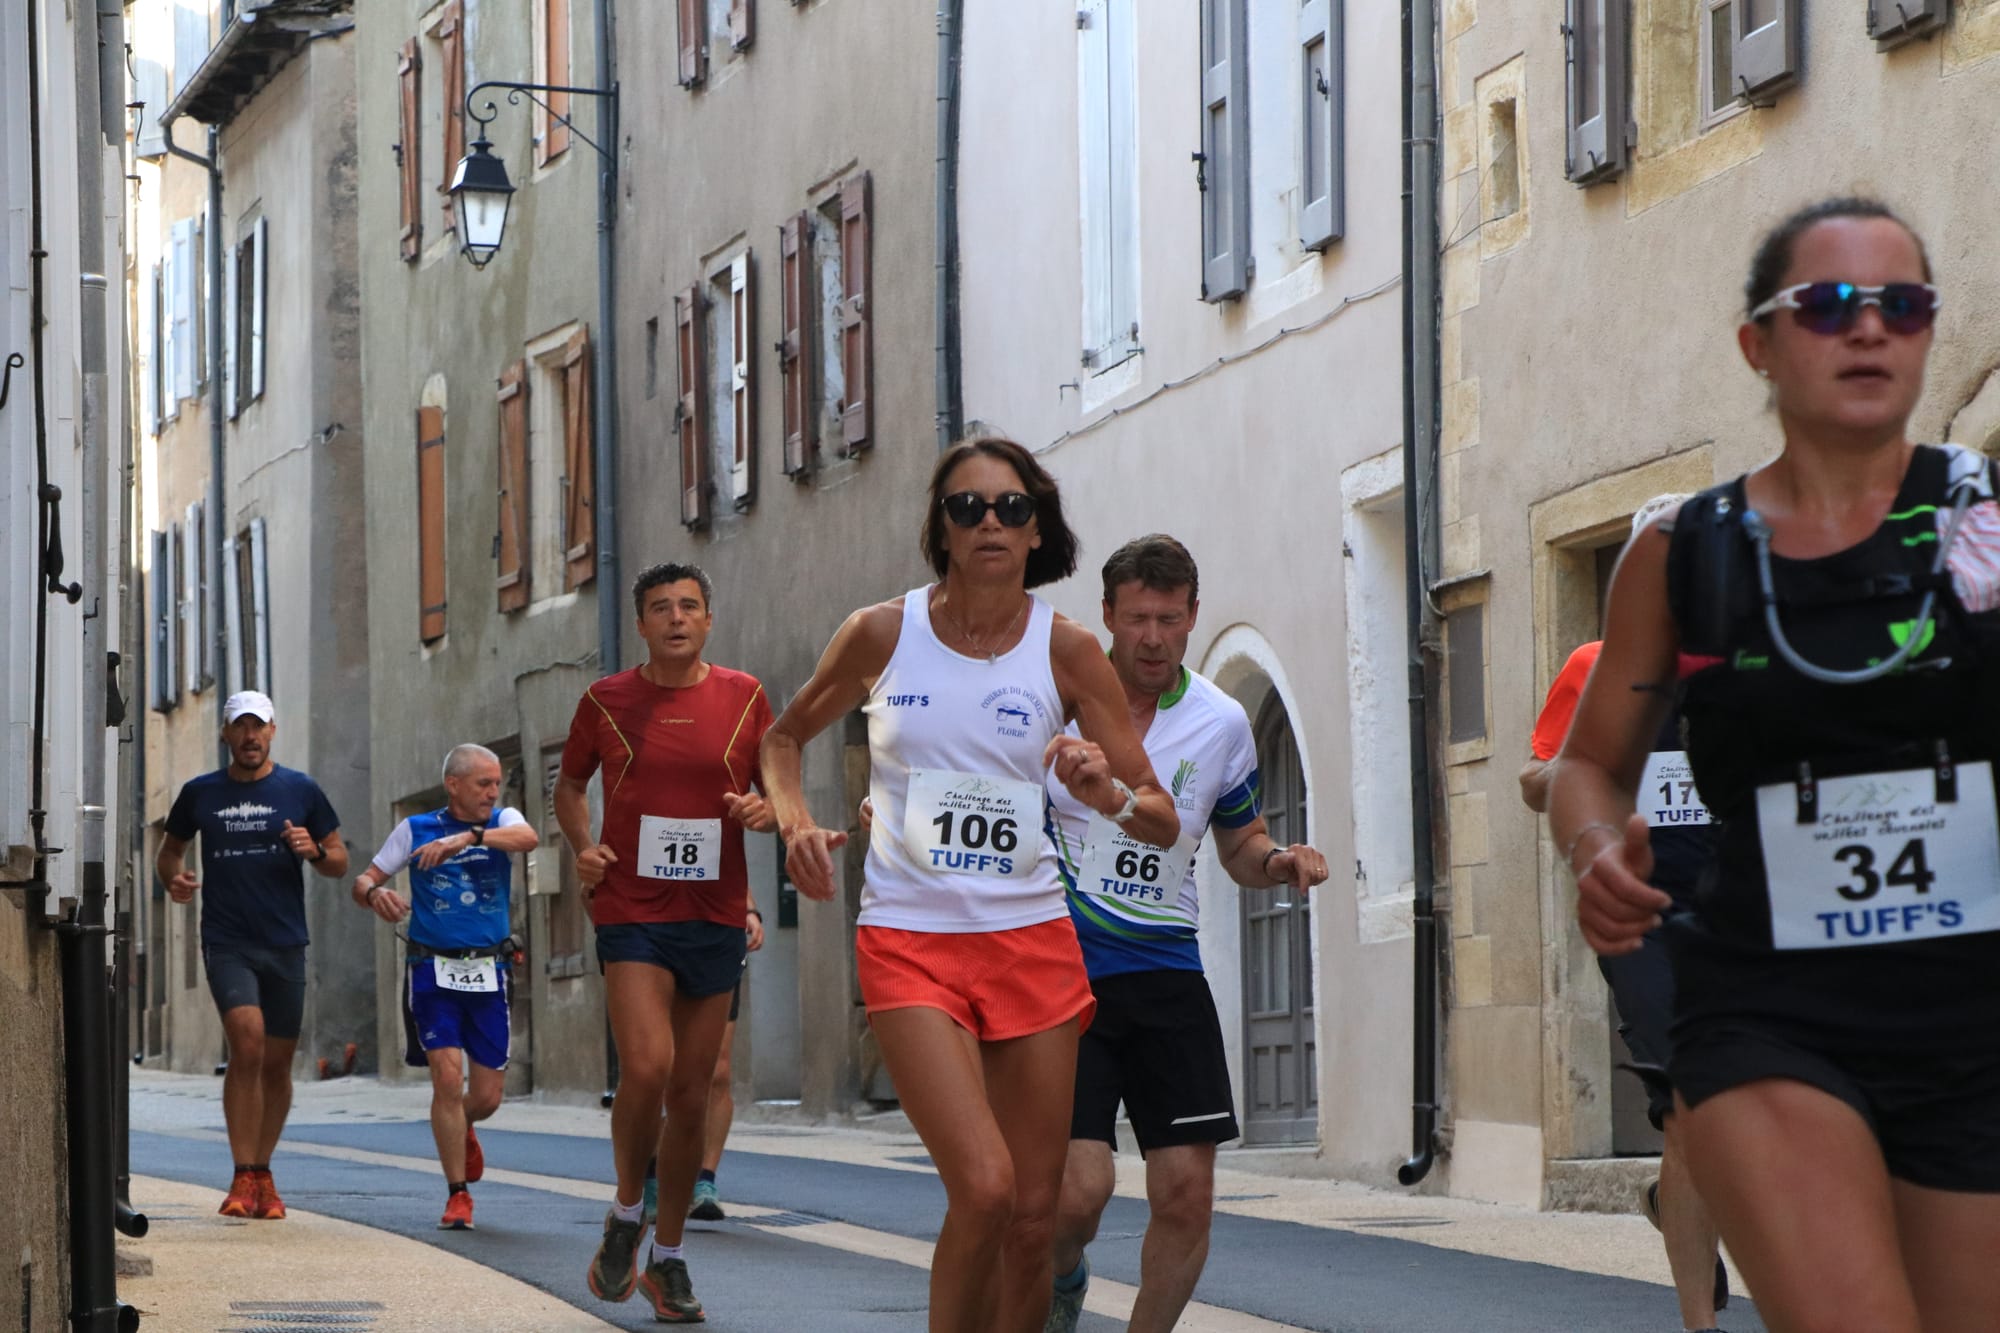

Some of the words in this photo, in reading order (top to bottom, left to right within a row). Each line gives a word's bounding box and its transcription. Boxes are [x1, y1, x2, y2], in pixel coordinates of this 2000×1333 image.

[1009, 686, 1021, 695] DU
[886, 695, 930, 708] TUFF'S
[938, 800, 971, 810] vallées
[976, 804, 1016, 815] cévenoles
[944, 792, 991, 805] Challenge
[996, 797, 1012, 806] des
[1822, 809, 1898, 826] Challenge
[932, 810, 1018, 853] 106
[664, 843, 698, 865] 18
[929, 848, 1013, 875] TUFF'S
[653, 865, 705, 878] TUFF'S
[1115, 850, 1161, 882] 66
[1833, 838, 1936, 903] 34
[1101, 878, 1164, 901] TUFF'S
[1816, 900, 1964, 940] TUFF'S
[447, 973, 485, 984] 144
